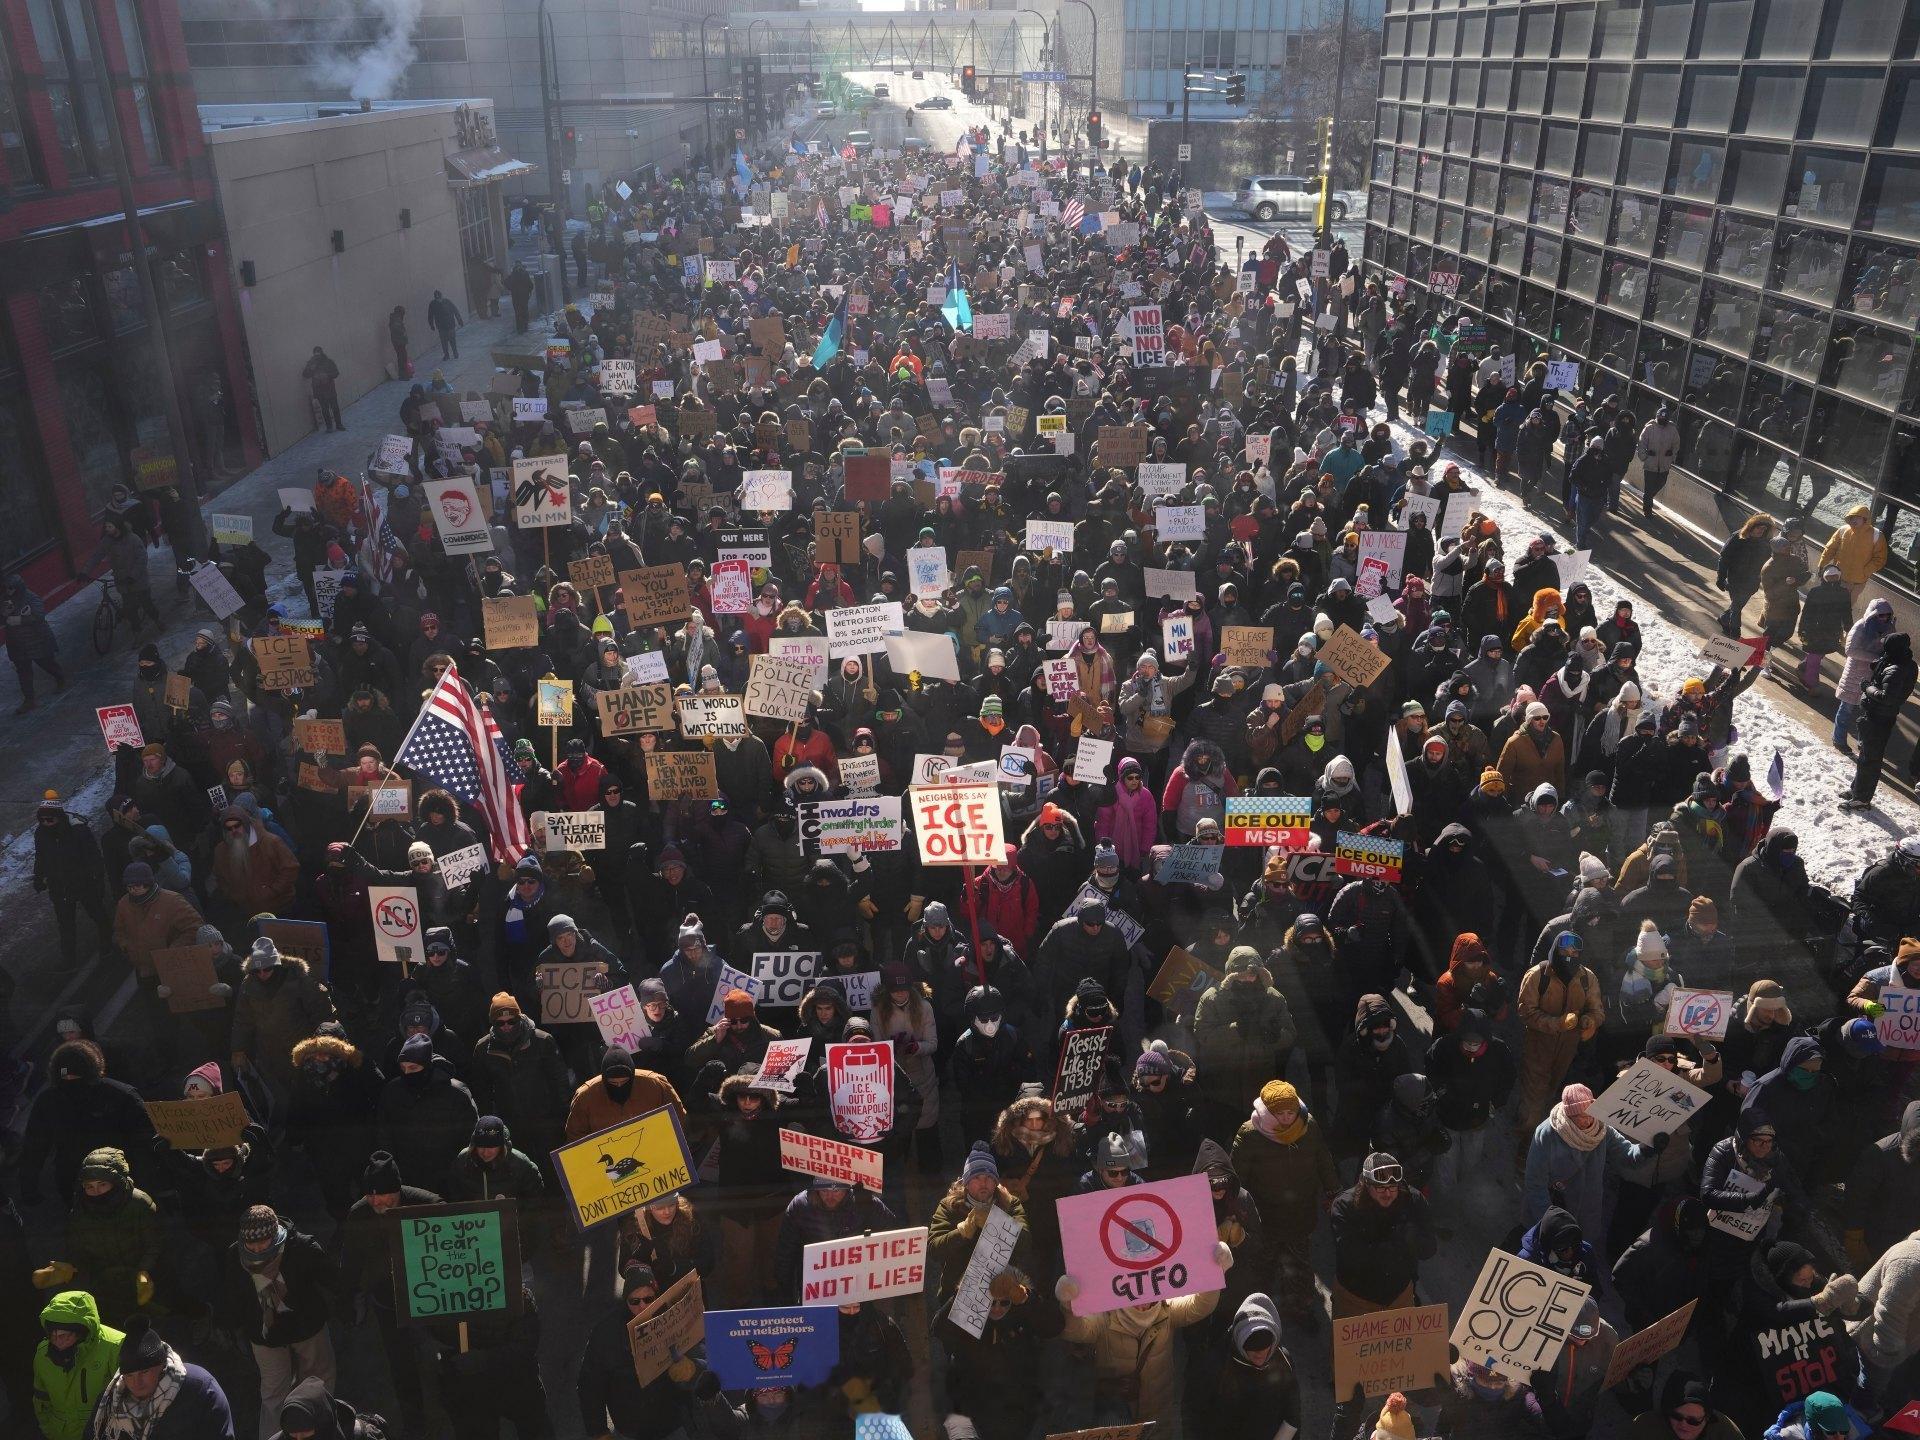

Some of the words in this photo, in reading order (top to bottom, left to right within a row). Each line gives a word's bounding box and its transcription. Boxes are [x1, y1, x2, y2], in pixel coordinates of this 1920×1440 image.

[1040, 72, 1054, 80] 3rd
[1134, 309, 1160, 325] NO
[1135, 325, 1161, 335] KINGS
[1136, 335, 1162, 350] NO
[1137, 350, 1164, 364] ICE
[601, 361, 614, 370] WE
[615, 360, 635, 371] KNOW
[608, 371, 627, 379] WHAT
[601, 381, 614, 390] WE
[515, 402, 532, 413] FUCK
[1008, 414, 1026, 424] OUT
[1007, 423, 1025, 433] NOW
[516, 459, 538, 469] DON'T
[541, 457, 564, 466] TREAD
[681, 485, 708, 497] ICE
[521, 512, 542, 524] ON
[545, 511, 567, 522] MN
[822, 513, 851, 524] ICE
[1168, 508, 1182, 516] ICE
[1184, 507, 1199, 516] ARE
[443, 532, 488, 544] COWARDICE
[721, 534, 738, 543] OUT
[743, 533, 764, 542] HERE
[820, 527, 853, 539] OUT
[1362, 534, 1375, 548] NO
[1380, 534, 1403, 549] MORE
[722, 553, 741, 561] FOR
[743, 552, 767, 561] GOOD
[573, 555, 610, 573] STOP
[571, 568, 612, 583] KILLING
[586, 577, 606, 586] US!
[629, 573, 650, 583] What
[653, 569, 675, 579] Would
[641, 581, 668, 592] YOU
[631, 592, 655, 604] Have
[657, 590, 673, 600] Done
[673, 588, 685, 597] In
[646, 598, 673, 610] 1939?
[832, 605, 881, 617] OPERATION
[833, 617, 864, 628] METRO
[865, 615, 891, 625] SIEGE:
[1112, 615, 1125, 623] NO
[835, 629, 848, 638] 0%
[851, 627, 882, 637] SAFETY
[1109, 622, 1128, 632] ICE
[1171, 623, 1187, 637] MN
[1227, 629, 1268, 642] RELEASE
[261, 637, 302, 655] ICE
[1239, 640, 1253, 648] THE
[1337, 630, 1363, 654] MORE
[1363, 649, 1385, 668] PUGS
[1223, 647, 1269, 659] TRUMPSTEIN
[1052, 661, 1067, 672] ICE
[1236, 657, 1259, 665] FILES
[1328, 650, 1368, 684] THUGS
[1337, 644, 1358, 661] LESS
[1358, 657, 1379, 677] ICE
[753, 664, 812, 690] POLICE
[606, 687, 667, 712] HANDS
[750, 682, 809, 707] STATE
[680, 698, 700, 711] THE
[704, 698, 739, 710] WORLD
[748, 700, 788, 717] LOOKS
[614, 708, 658, 728] OFF
[705, 711, 717, 722] IS
[684, 723, 747, 735] WATCHING
[649, 755, 667, 767] THE
[672, 753, 711, 766] SMALLEST
[841, 760, 876, 770] INJUSTICE
[657, 766, 676, 778] MEN
[677, 765, 698, 777] WHO
[843, 769, 876, 779] ANYWHERE
[926, 762, 947, 778] ICE
[973, 770, 990, 779] FOR
[653, 779, 678, 790] EVER
[680, 777, 707, 788] LIVED
[918, 793, 970, 804] NEIGHBORS
[971, 792, 988, 801] SAY
[547, 815, 574, 826] SAY
[921, 803, 988, 831] ICE
[1228, 814, 1261, 828] ICE
[1265, 814, 1310, 828] OUT
[564, 834, 602, 845] NAME
[1245, 830, 1291, 844] MSP
[851, 839, 898, 853] TRUMP
[926, 833, 994, 858] OUT!
[440, 852, 464, 867] THIS
[468, 846, 481, 859] IS
[1337, 847, 1363, 862] ICE
[1366, 851, 1401, 867] OUT
[1170, 860, 1198, 871] PEOPLE
[1201, 862, 1218, 873] NOT
[1350, 862, 1387, 876] MSP
[381, 905, 414, 928] ICE
[545, 967, 597, 991] ICE
[720, 967, 760, 997] ICE
[545, 993, 596, 1019] OUT
[592, 986, 635, 1015] ICE
[600, 1003, 637, 1027] OUT
[1684, 1005, 1718, 1027] ICE
[612, 1020, 635, 1036] OF
[1066, 1028, 1108, 1056] Resist
[1063, 1070, 1093, 1092] 1938
[1627, 1069, 1671, 1100] PLOW
[852, 1083, 873, 1095] I.C.E.
[848, 1094, 864, 1104] OUT
[866, 1093, 877, 1103] OF
[837, 1102, 888, 1116] MINNEAPOLIS
[1620, 1089, 1649, 1109] ICE
[1649, 1104, 1683, 1123] OUT
[1608, 1108, 1653, 1129] MN
[781, 1129, 878, 1164] SUPPORT
[809, 1148, 852, 1168] OUR
[782, 1154, 883, 1191] NEIGHBORS
[413, 1219, 441, 1236] Do
[452, 1217, 486, 1240] you
[424, 1232, 480, 1254] Hear
[446, 1250, 467, 1261] the
[813, 1236, 924, 1271] JUSTICE
[420, 1249, 497, 1287] People
[805, 1276, 855, 1301] NOT
[868, 1264, 924, 1291] LIES
[1111, 1261, 1188, 1303] GTFO
[412, 1277, 501, 1315] Sing?
[1479, 1257, 1586, 1337] ICE
[738, 1318, 757, 1327] We
[760, 1315, 805, 1327] protect
[1341, 1322, 1389, 1343] SHAME
[1393, 1316, 1413, 1333] ON
[1416, 1313, 1444, 1331] YOU
[729, 1328, 755, 1338] our
[756, 1324, 815, 1337] neighbors
[1468, 1308, 1564, 1362] OUT
[1757, 1315, 1835, 1360] MAKE
[1359, 1338, 1414, 1358] EMMER
[1794, 1344, 1810, 1361] IT
[1358, 1358, 1406, 1378] NOEM
[1775, 1345, 1838, 1402] STOP
